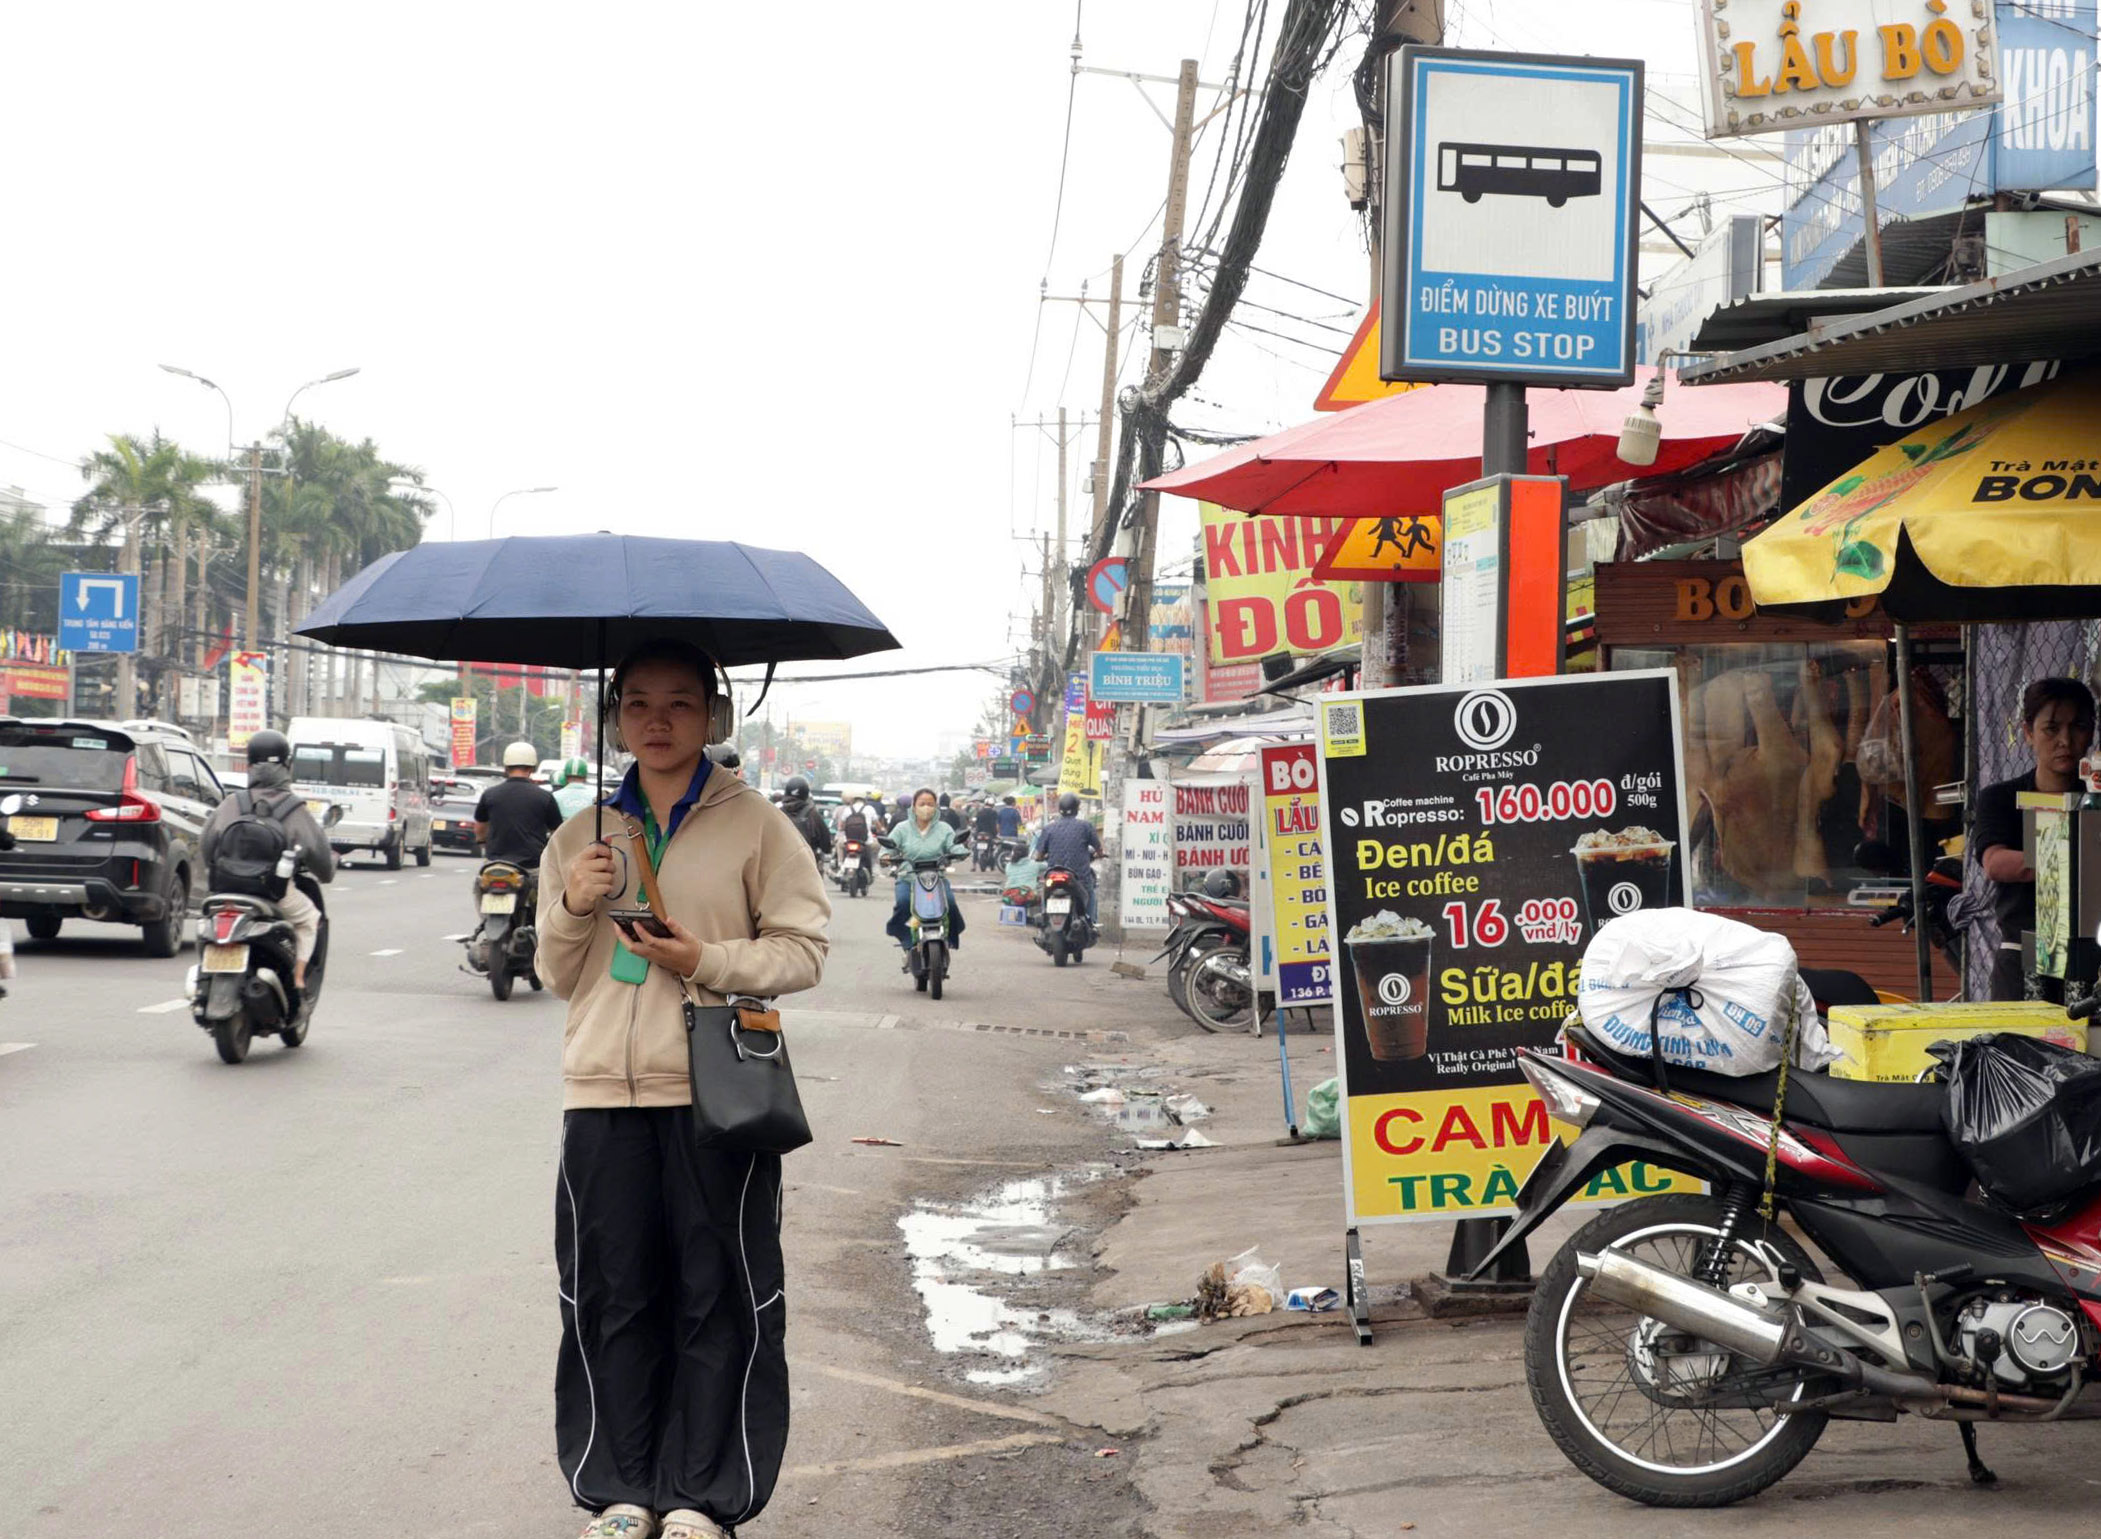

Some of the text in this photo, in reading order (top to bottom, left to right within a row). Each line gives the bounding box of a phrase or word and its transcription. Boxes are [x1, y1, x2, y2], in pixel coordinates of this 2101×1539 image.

[1733, 0, 1965, 97] LẨU BÒ
[2003, 48, 2090, 151] KHOA
[1420, 278, 1613, 322] ĐIỂM DỪNG XE BUÝT
[1439, 328, 1595, 360] BUS STOP
[1990, 460, 2031, 472] Trà
[1205, 516, 1336, 579] KINH
[1216, 577, 1343, 659] ĐÔ
[1103, 671, 1171, 687] BÌNH TRIỆU
[1066, 732, 1078, 753] 2
[1271, 752, 1315, 791] BÒ
[1462, 770, 1514, 782] Café Pha Máy
[1620, 772, 1662, 793] đ/gói
[1176, 784, 1215, 815] BÁNH
[1383, 795, 1455, 808] Coffee machine
[1475, 778, 1617, 825] 160.000
[1627, 794, 1658, 808] 500g
[1126, 810, 1164, 824] NAM
[1274, 797, 1320, 836] LẨU
[1363, 800, 1465, 828] Ropresso:
[1177, 821, 1213, 841] BÁNH
[1142, 850, 1156, 861] NUI
[1177, 846, 1225, 867] BÁNH
[1356, 830, 1495, 870] Đen/đá
[1365, 871, 1479, 899] Ice coffee
[1442, 899, 1509, 949] 16
[1291, 986, 1325, 998] 136 P.
[1369, 1004, 1422, 1017] ROPRESSO
[1448, 1000, 1577, 1026] Milk Ice coffe
[1436, 1059, 1516, 1075] Really Original
[1442, 1051, 1467, 1064] Thật
[1470, 1050, 1485, 1060] Cà
[1488, 1049, 1507, 1059] Phê
[1374, 1099, 1550, 1156] CAM
